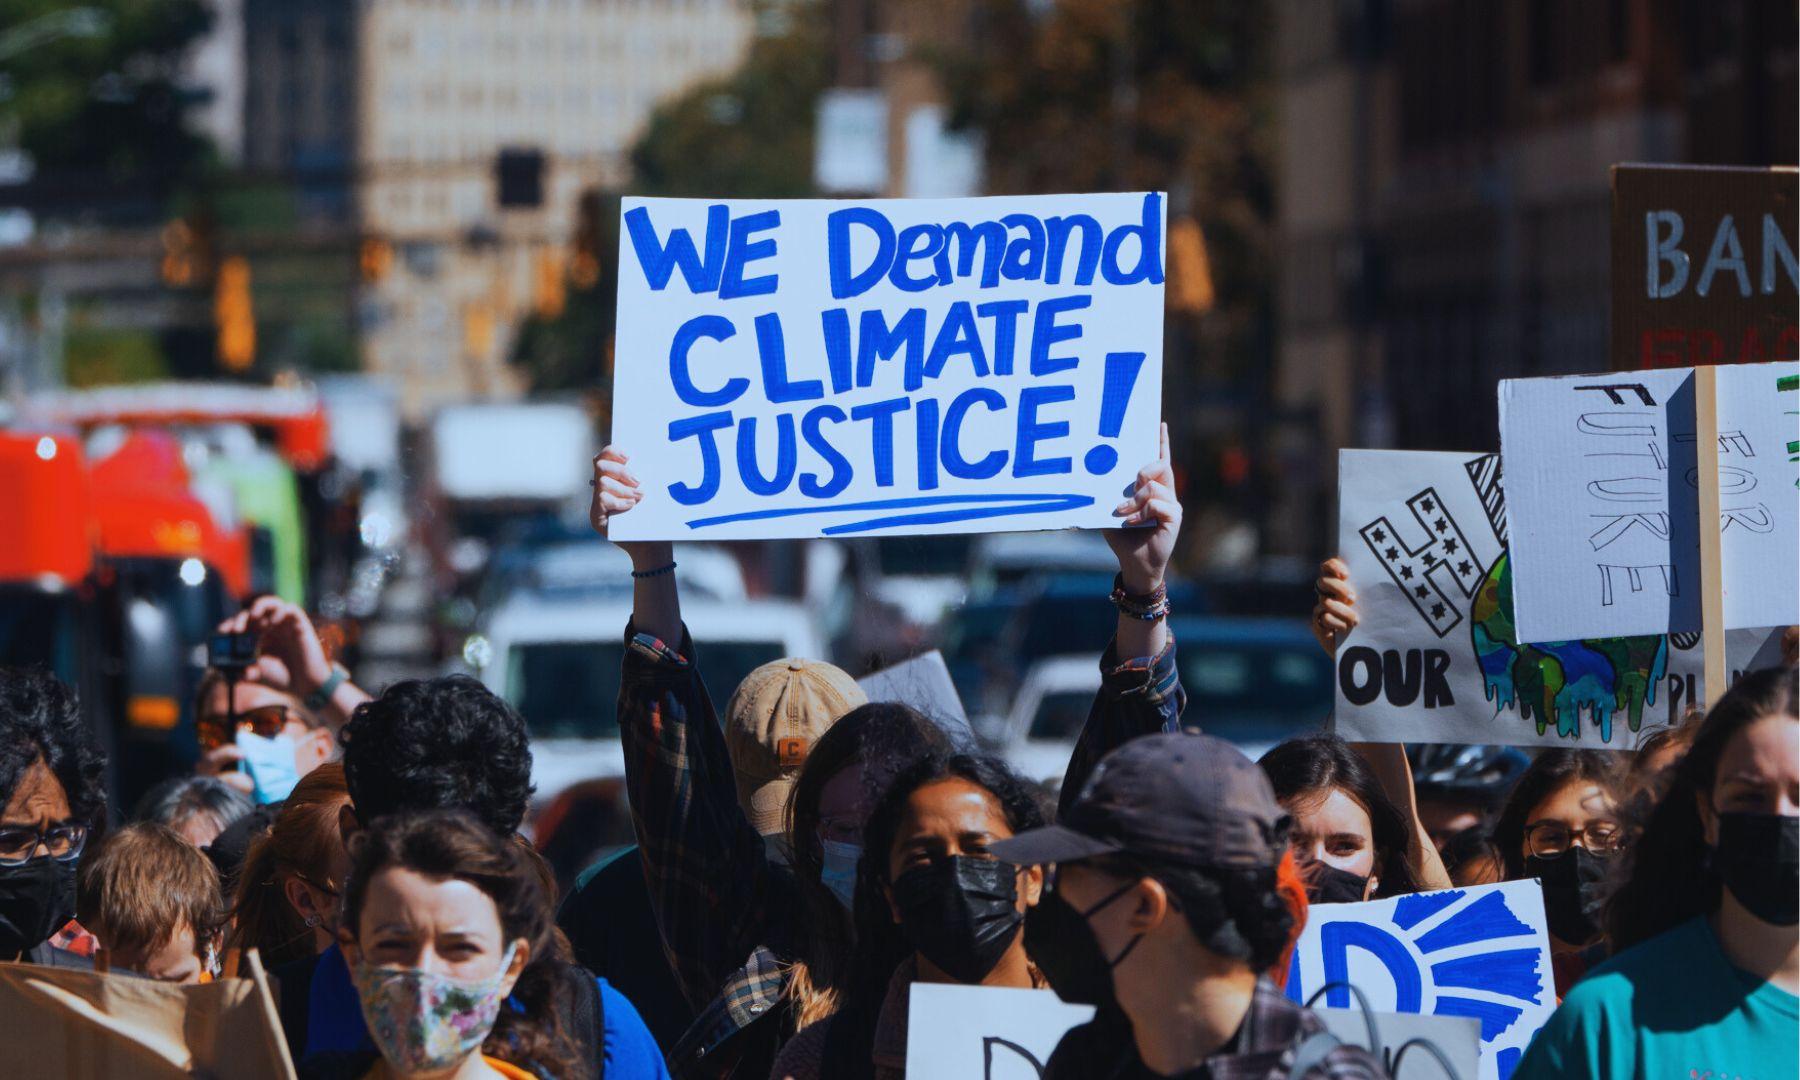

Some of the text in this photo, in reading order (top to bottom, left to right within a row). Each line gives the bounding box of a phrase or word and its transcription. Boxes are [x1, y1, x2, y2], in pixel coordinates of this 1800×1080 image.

[624, 191, 1165, 299] WE Demand
[1646, 210, 1799, 298] BAN
[669, 295, 1092, 407] CLIMATE
[668, 352, 1146, 506] JUSTICE!
[1573, 383, 1680, 607] FUTURE
[1339, 645, 1455, 709] OUR
